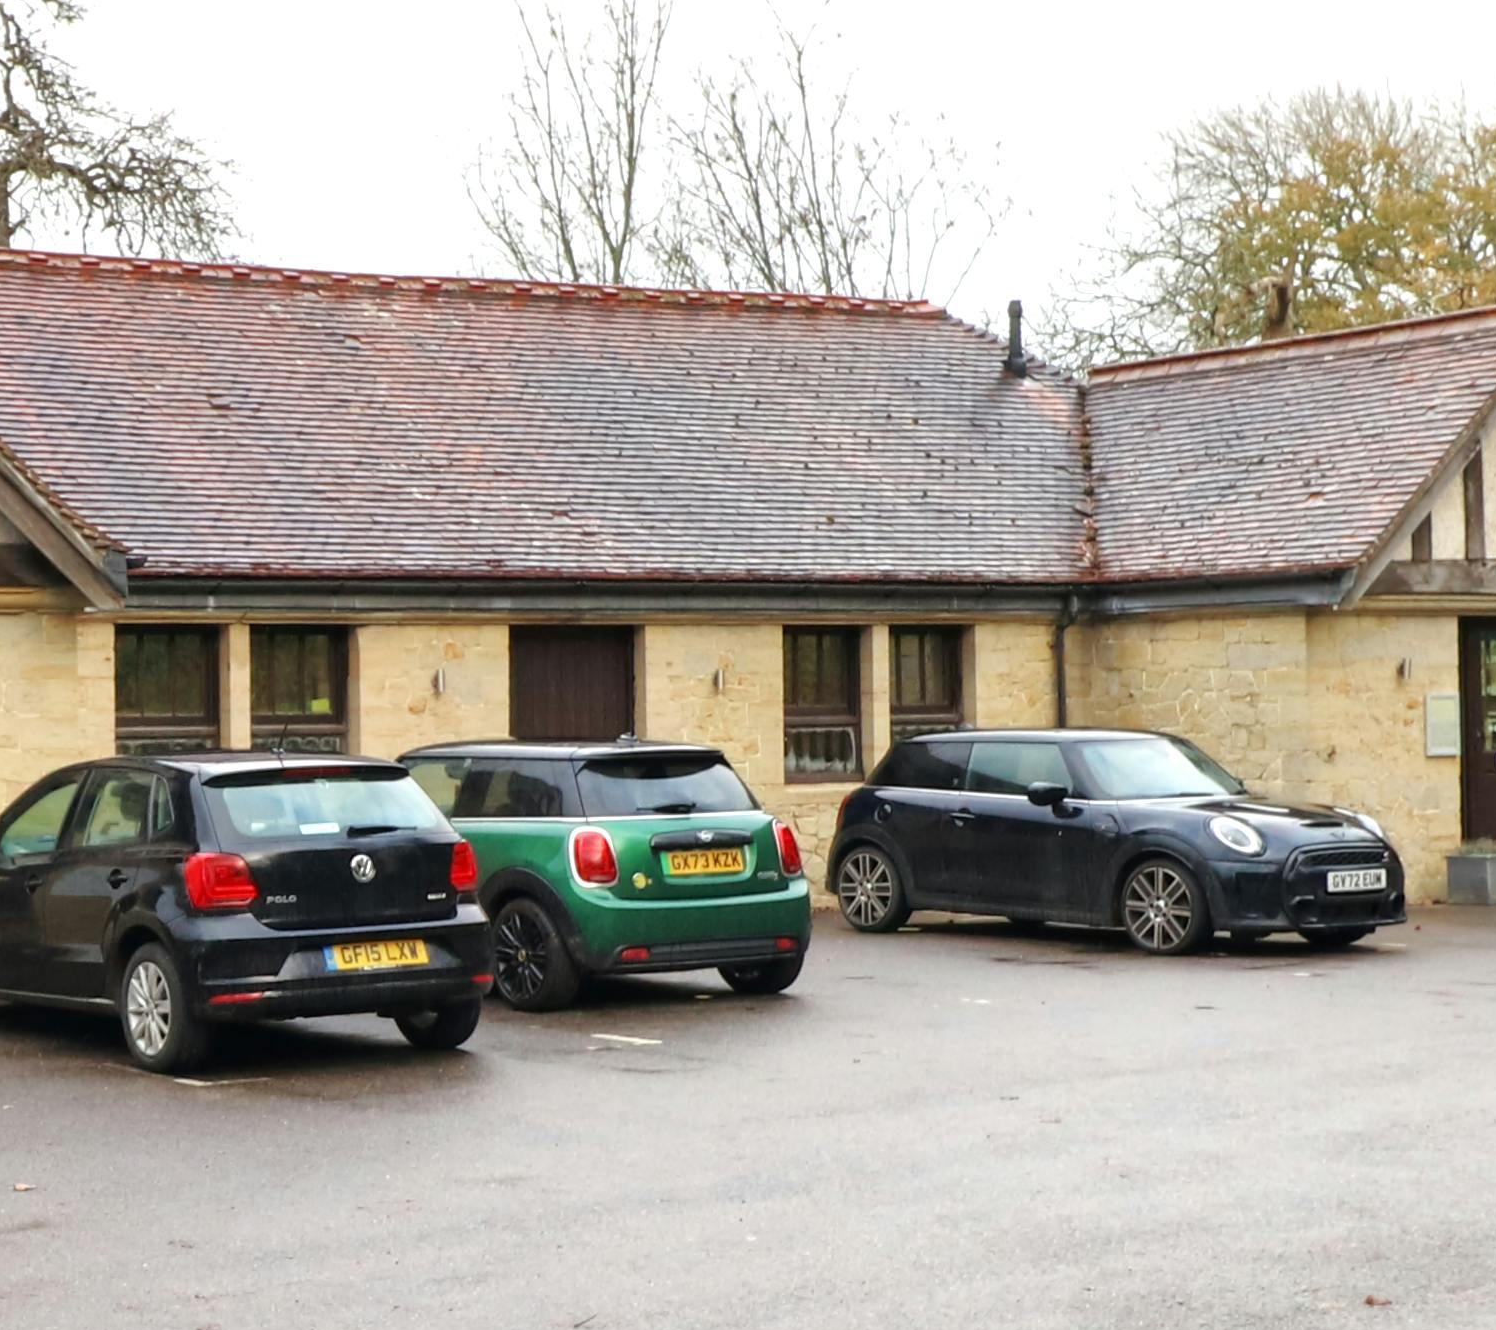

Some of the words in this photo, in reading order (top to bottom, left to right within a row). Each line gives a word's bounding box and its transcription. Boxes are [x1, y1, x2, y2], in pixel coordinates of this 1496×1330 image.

[671, 853, 709, 871] GX73
[713, 851, 742, 868] KZK
[1332, 873, 1360, 889] GV72
[1362, 871, 1382, 887] EUM
[266, 894, 298, 904] POLO
[340, 944, 382, 965] GF15
[386, 941, 419, 961] LXW
